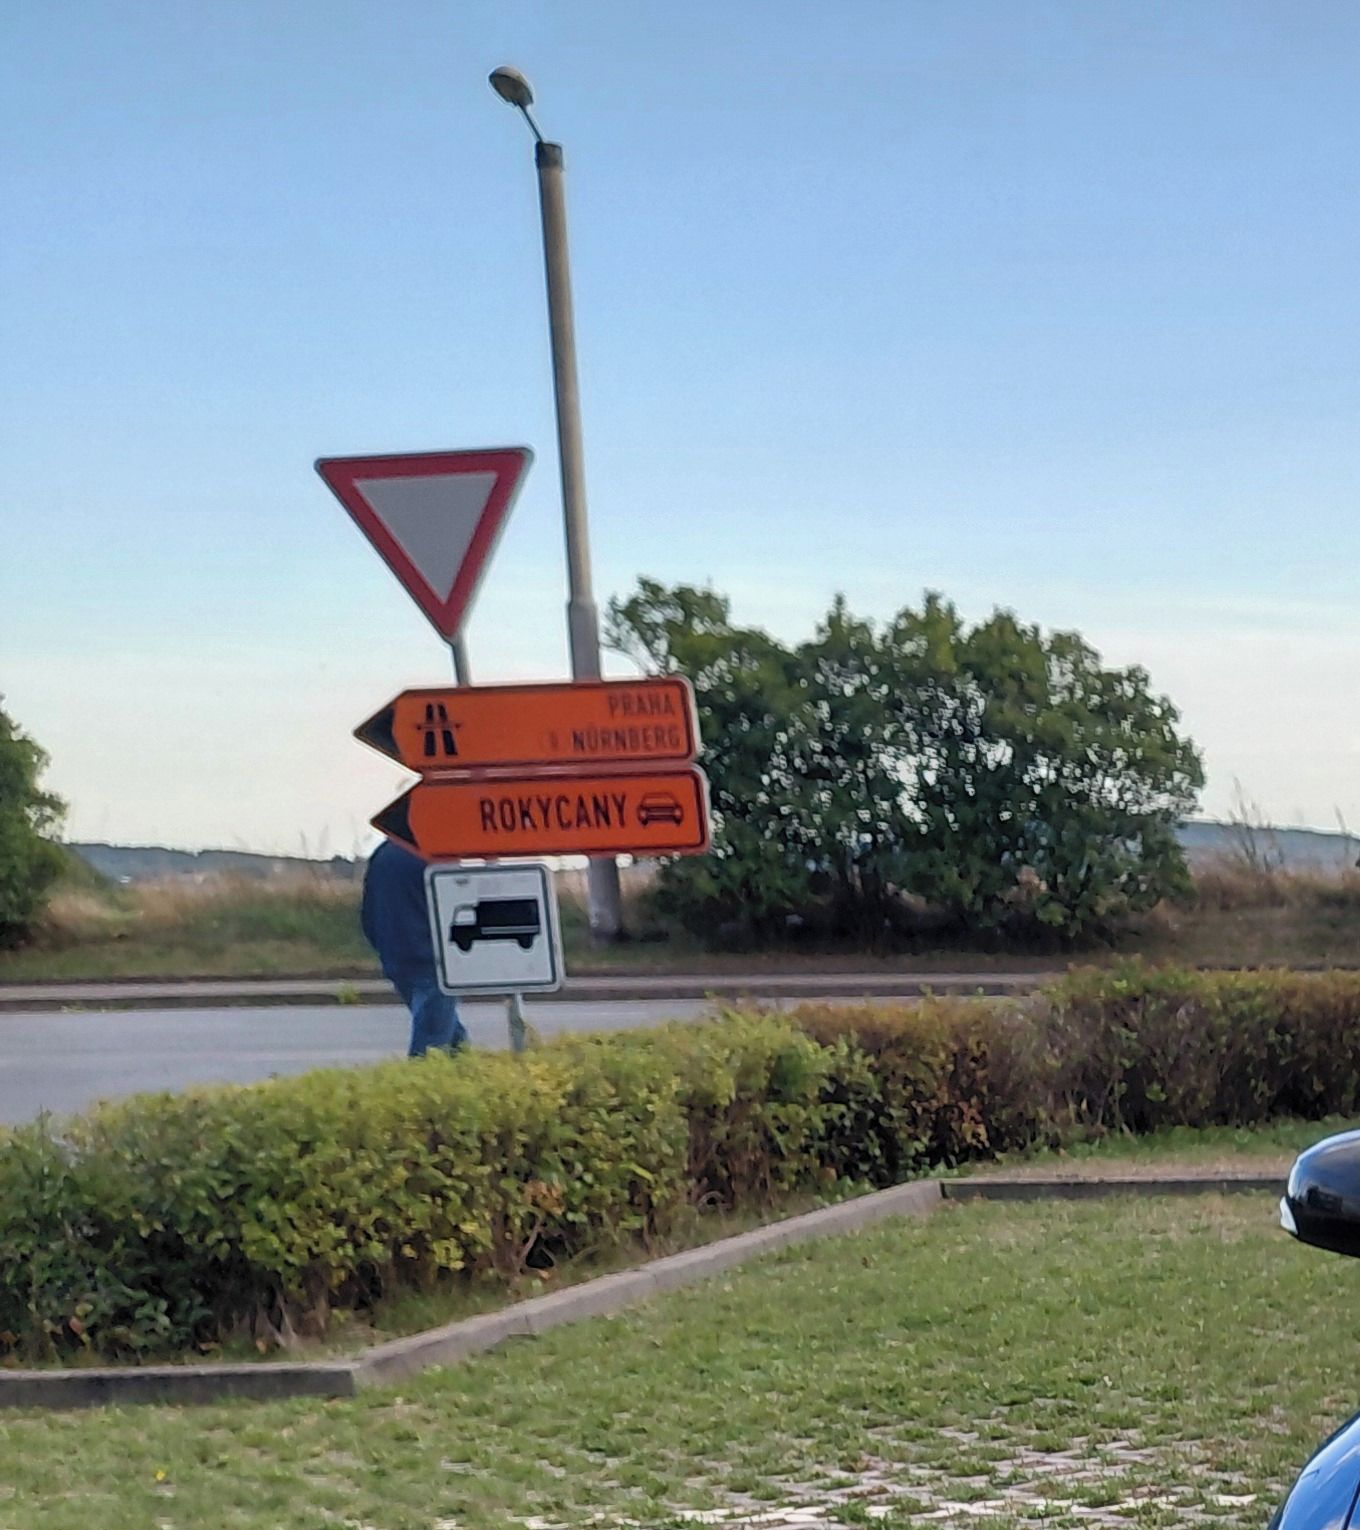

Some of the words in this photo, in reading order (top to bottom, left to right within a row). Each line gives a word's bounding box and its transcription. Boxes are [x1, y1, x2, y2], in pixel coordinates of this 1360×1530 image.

[608, 692, 675, 719] PRAHA
[572, 722, 681, 752] NÜRNBERG
[480, 795, 627, 834] ROKYCANY
